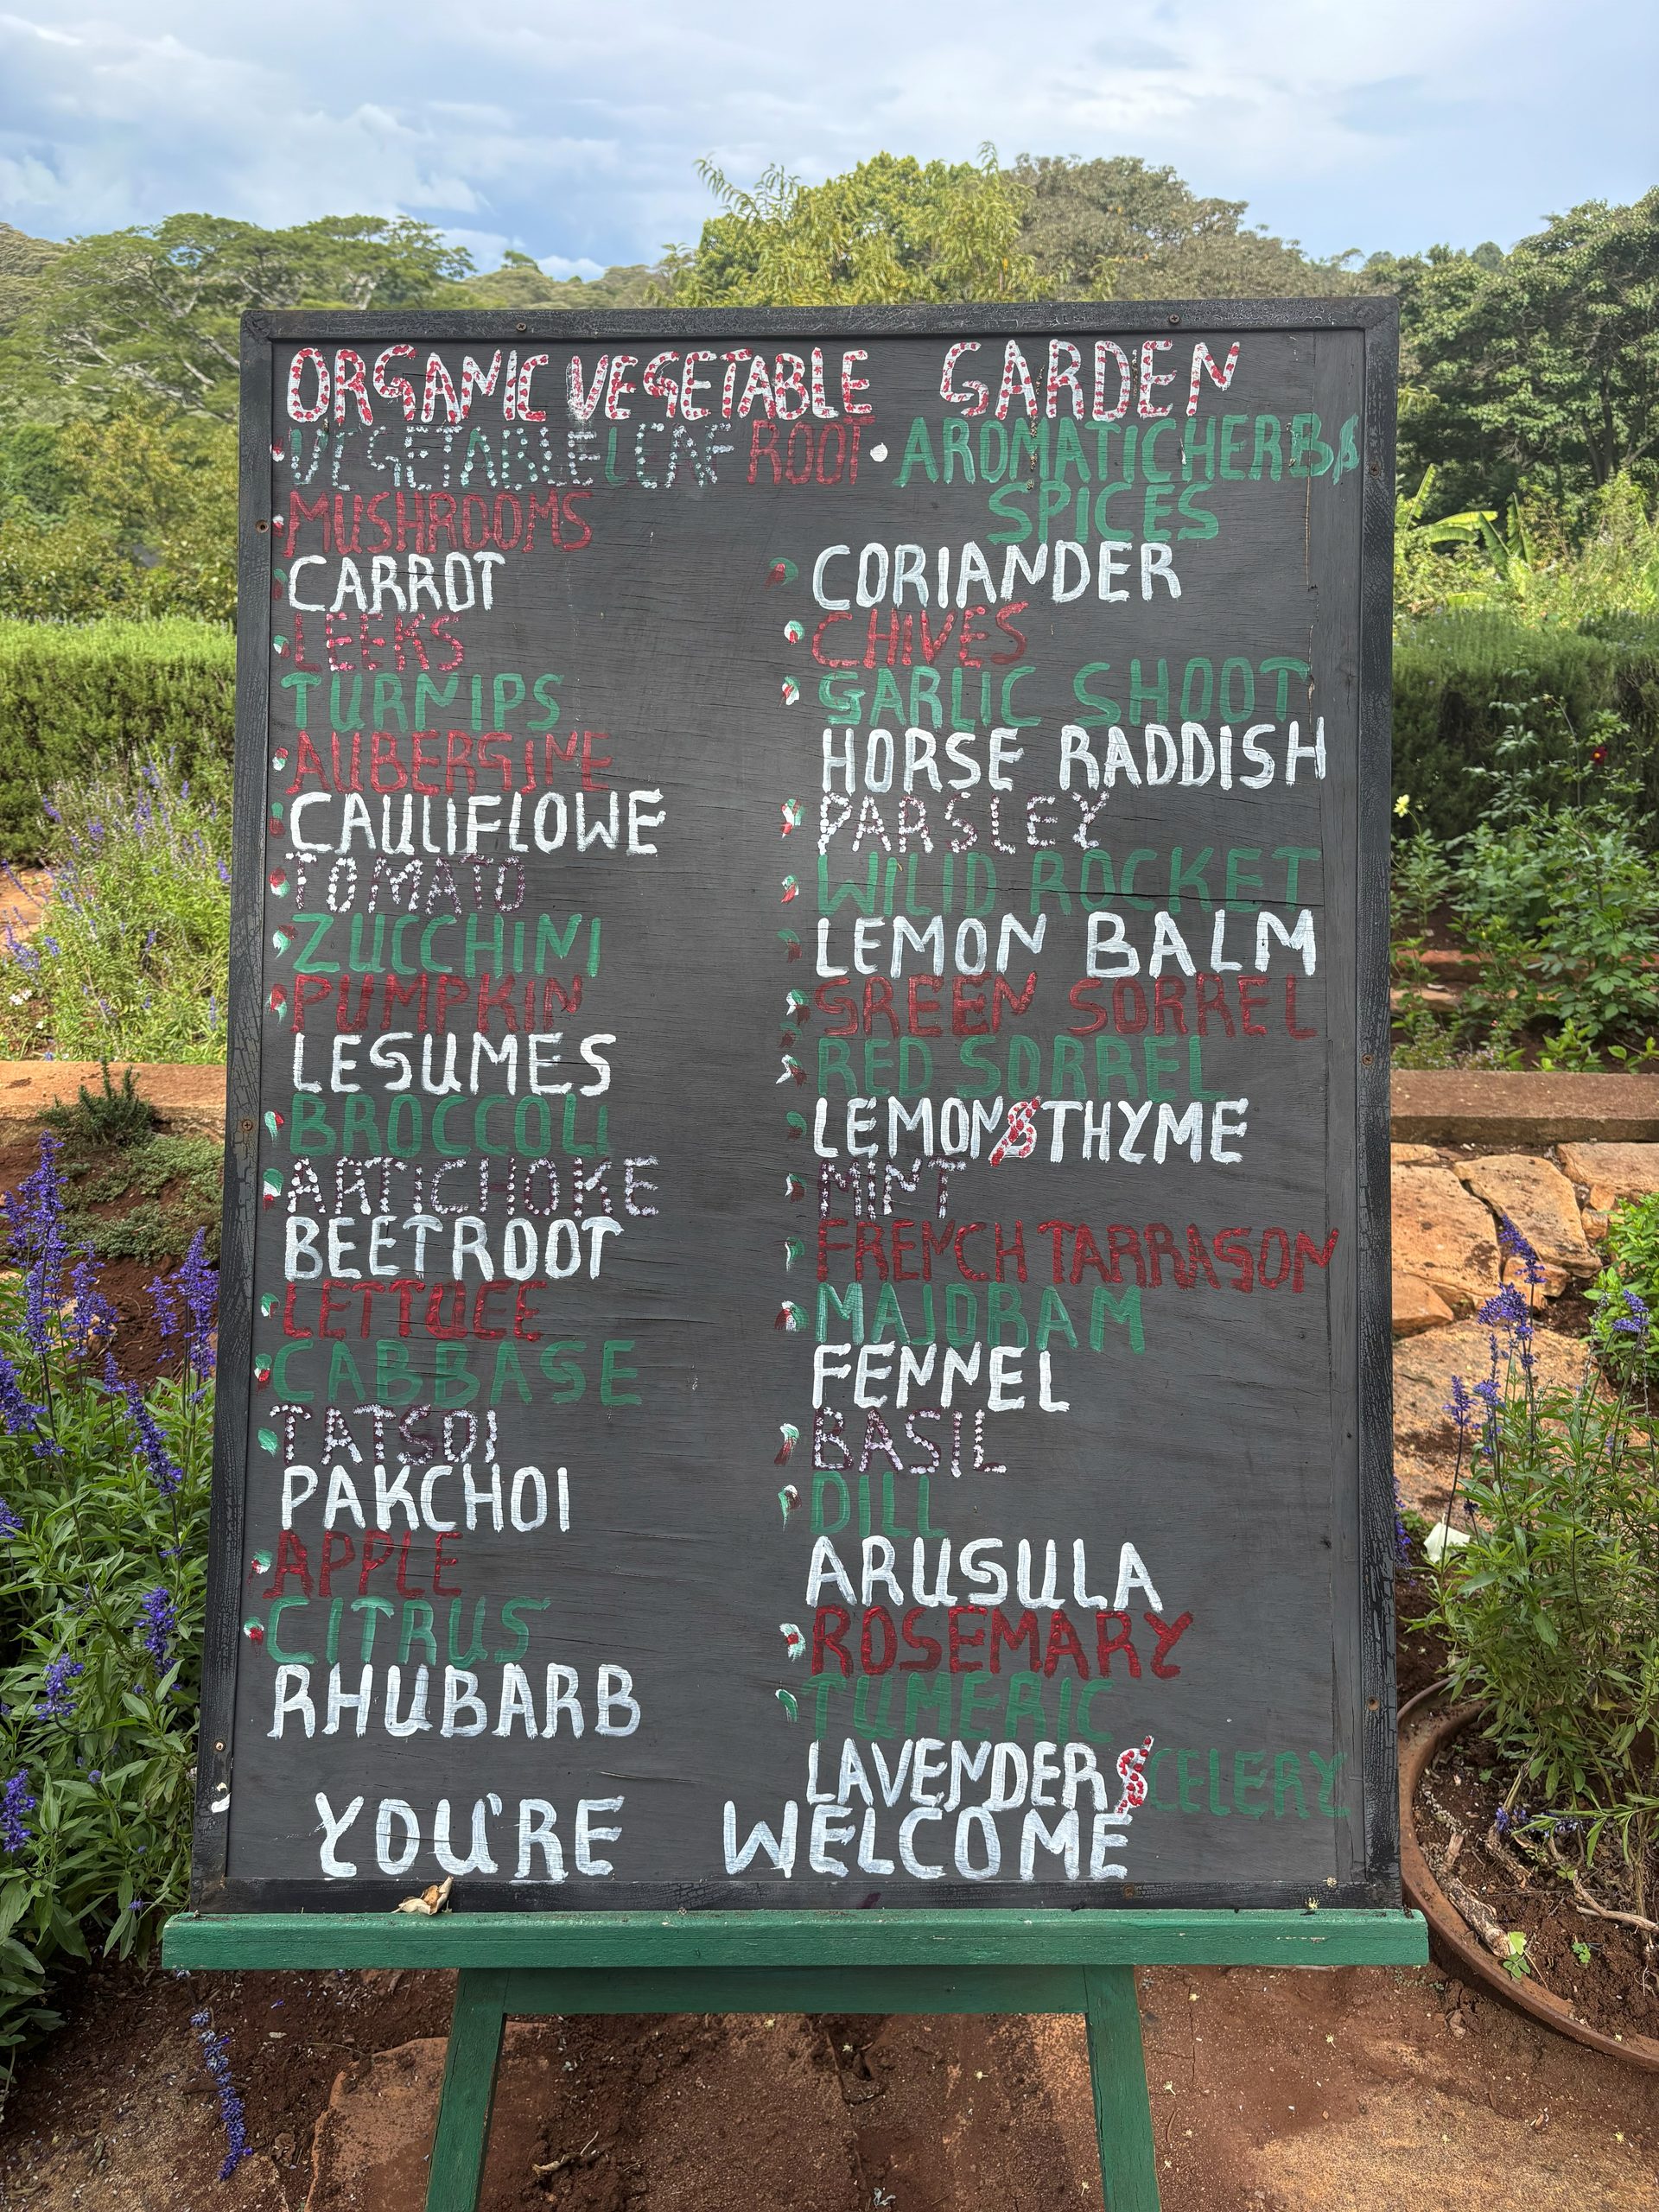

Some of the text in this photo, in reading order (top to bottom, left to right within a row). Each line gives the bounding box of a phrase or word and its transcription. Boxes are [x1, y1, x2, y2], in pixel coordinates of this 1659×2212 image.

[286, 339, 1241, 424] ORGANIC VEGETABLE GARDEN
[288, 423, 600, 491] VEGETABLE
[747, 415, 874, 486] ROOT
[283, 490, 594, 558] MUSHROOMS
[987, 480, 1219, 545] SPICES
[288, 551, 505, 613] CARROT
[813, 540, 1183, 611] CORIANDER
[295, 612, 466, 672] LEEKS
[811, 601, 1030, 670] CHIVES
[280, 671, 565, 734] TURNIPS
[818, 657, 1312, 730] GARLIC SHOOT
[821, 715, 1327, 793] HORSE RADDISH
[289, 788, 666, 857] CAULIFLOWE
[817, 790, 1109, 855] PARSLEY
[284, 851, 525, 916] TOMATO
[1028, 846, 1321, 916] ROCKET
[292, 912, 603, 978] ZUCCHINI
[815, 908, 1318, 979] LEMON BALM
[289, 973, 584, 1034] PUMPKIN
[1066, 973, 1318, 1039] SORREL
[817, 1033, 1230, 1103] RED SORREL
[289, 1092, 610, 1158] BROCCOLI
[286, 1155, 660, 1217] ARTICHOKE
[816, 1156, 967, 1220] MINT
[283, 1214, 626, 1281] BEETROOT
[817, 1217, 1029, 1284] FRENCH
[282, 1279, 549, 1342] LETTUCE
[815, 1281, 1147, 1355] MAJORAM
[811, 1341, 1071, 1414] FENNEL
[269, 1403, 498, 1466] TATSOI
[811, 1405, 1007, 1478] BASIL
[281, 1463, 570, 1533] PAKCHOI
[810, 1471, 950, 1540] DILL
[263, 1529, 463, 1599] APPLE
[266, 1595, 552, 1669] CITRUS
[810, 1604, 1195, 1680] ROSEMARY
[266, 1662, 642, 1739] RHUBARB
[802, 1671, 1116, 1745] TUMERIC
[806, 1737, 1109, 1813] LAVENDER
[1150, 1746, 1351, 1819] CELERY
[314, 1791, 1132, 1884] YOU'RE WELCOME
